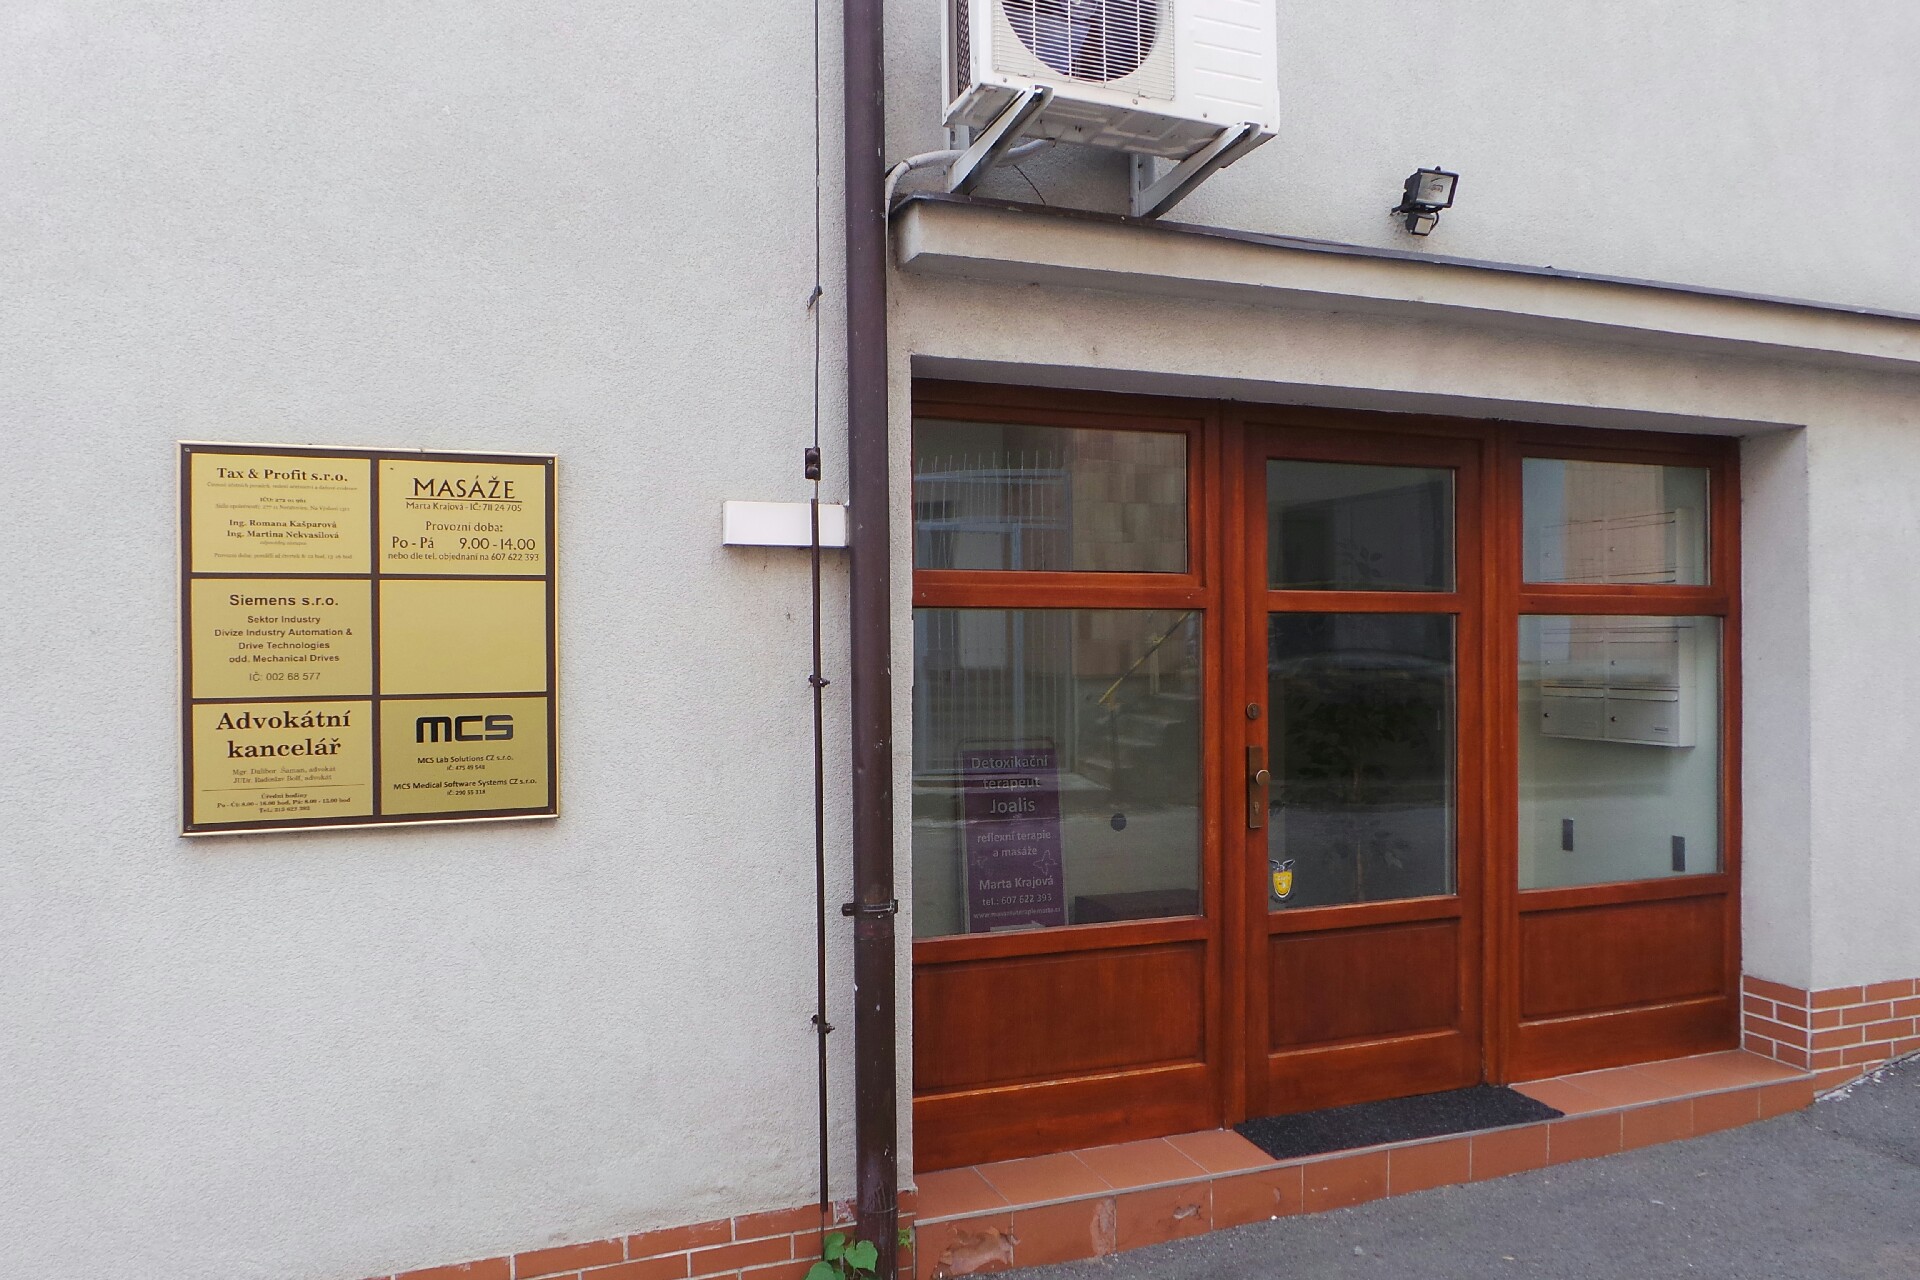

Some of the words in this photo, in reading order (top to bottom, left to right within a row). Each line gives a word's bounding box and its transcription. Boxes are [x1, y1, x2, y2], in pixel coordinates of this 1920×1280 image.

[216, 467, 244, 479] Tax
[248, 468, 259, 479] &
[264, 469, 307, 481] Profit
[310, 471, 348, 482] s.r.o.
[413, 475, 516, 499] MASÁŽE
[406, 501, 431, 510] Marta
[432, 502, 464, 511] Krajová
[495, 503, 506, 511] 24
[506, 503, 522, 512] 705
[229, 519, 247, 528] Ing.
[249, 520, 287, 528] Romana
[289, 520, 337, 529] Kašparová
[425, 520, 471, 532] Provozní
[473, 522, 503, 532] doba:
[227, 530, 245, 538] Ing.
[247, 530, 284, 539] Martina
[285, 531, 339, 539] Nekvasilová
[392, 536, 409, 549] Po
[420, 536, 434, 549] Pá
[459, 537, 490, 550] 9.00
[500, 538, 536, 550] 14.00
[388, 552, 409, 560] nebo
[410, 552, 423, 560] dle
[424, 552, 437, 560] tel.
[438, 552, 478, 562] objednání
[491, 552, 506, 561] 607
[507, 553, 523, 561] 622
[524, 553, 539, 562] 393
[229, 594, 296, 606] Siemens
[301, 596, 339, 606] s.r.o.
[247, 615, 278, 623] Sektor
[281, 615, 321, 624] Industry
[214, 629, 243, 637] Divize
[246, 629, 285, 637] Industry
[288, 628, 343, 636] Automation
[345, 628, 353, 636] &
[238, 642, 264, 650] Drive
[266, 641, 330, 651] Technologies
[229, 655, 250, 663] odd.
[309, 654, 340, 662] Drives
[266, 673, 284, 681] 002
[302, 672, 321, 681] 577
[215, 709, 351, 730] Advokátní
[227, 737, 342, 759] kancelář
[450, 755, 484, 763] Solutions
[971, 755, 1048, 769] Detoxikační
[393, 782, 411, 790] MCS
[412, 781, 443, 789] Medical
[444, 779, 476, 788] Software
[477, 779, 507, 788] Systems
[982, 776, 1041, 791] terapeut
[989, 797, 1036, 814] Joalis
[977, 829, 1016, 844] reflexní
[1017, 828, 1051, 842] terapie
[992, 849, 999, 858] a
[1001, 846, 1038, 857] masáže
[979, 880, 1012, 890] Marta
[1015, 875, 1054, 889] Krajová
[982, 897, 999, 906] tel.:
[1001, 896, 1017, 905] 607
[1019, 895, 1035, 904] 622
[1036, 893, 1052, 902] 393
